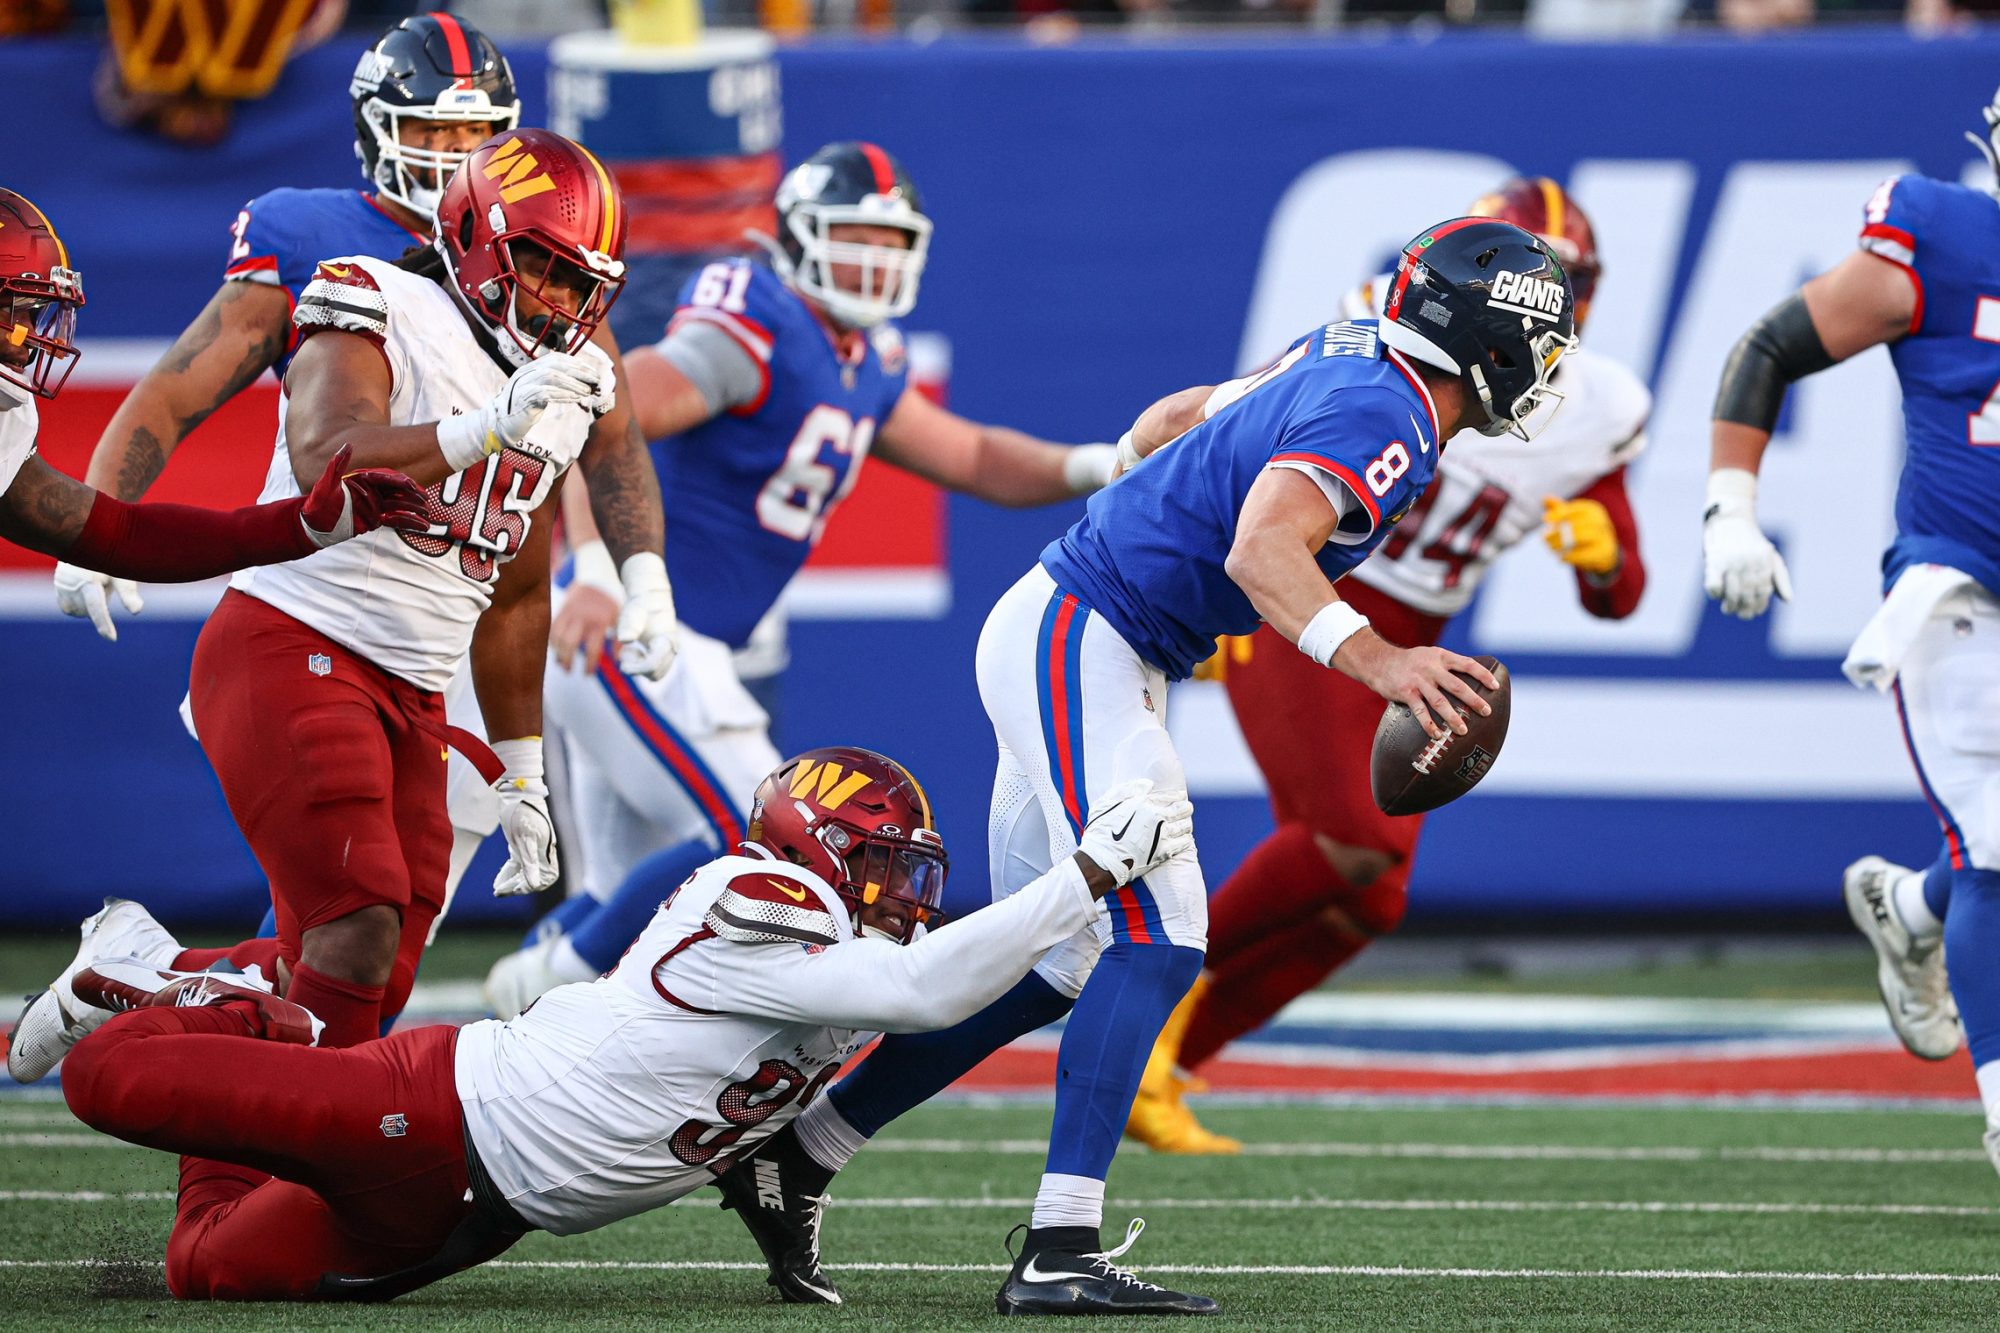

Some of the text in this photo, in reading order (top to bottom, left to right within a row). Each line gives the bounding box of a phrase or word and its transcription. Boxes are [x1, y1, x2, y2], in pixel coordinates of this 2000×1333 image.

[482, 137, 556, 204] W
[691, 262, 752, 313] 61
[1392, 288, 1401, 307] 8
[1490, 269, 1565, 316] GIANTS
[755, 403, 876, 547] 61
[1365, 440, 1412, 498] 8
[788, 758, 874, 811] W
[753, 1157, 786, 1212] NIKE
